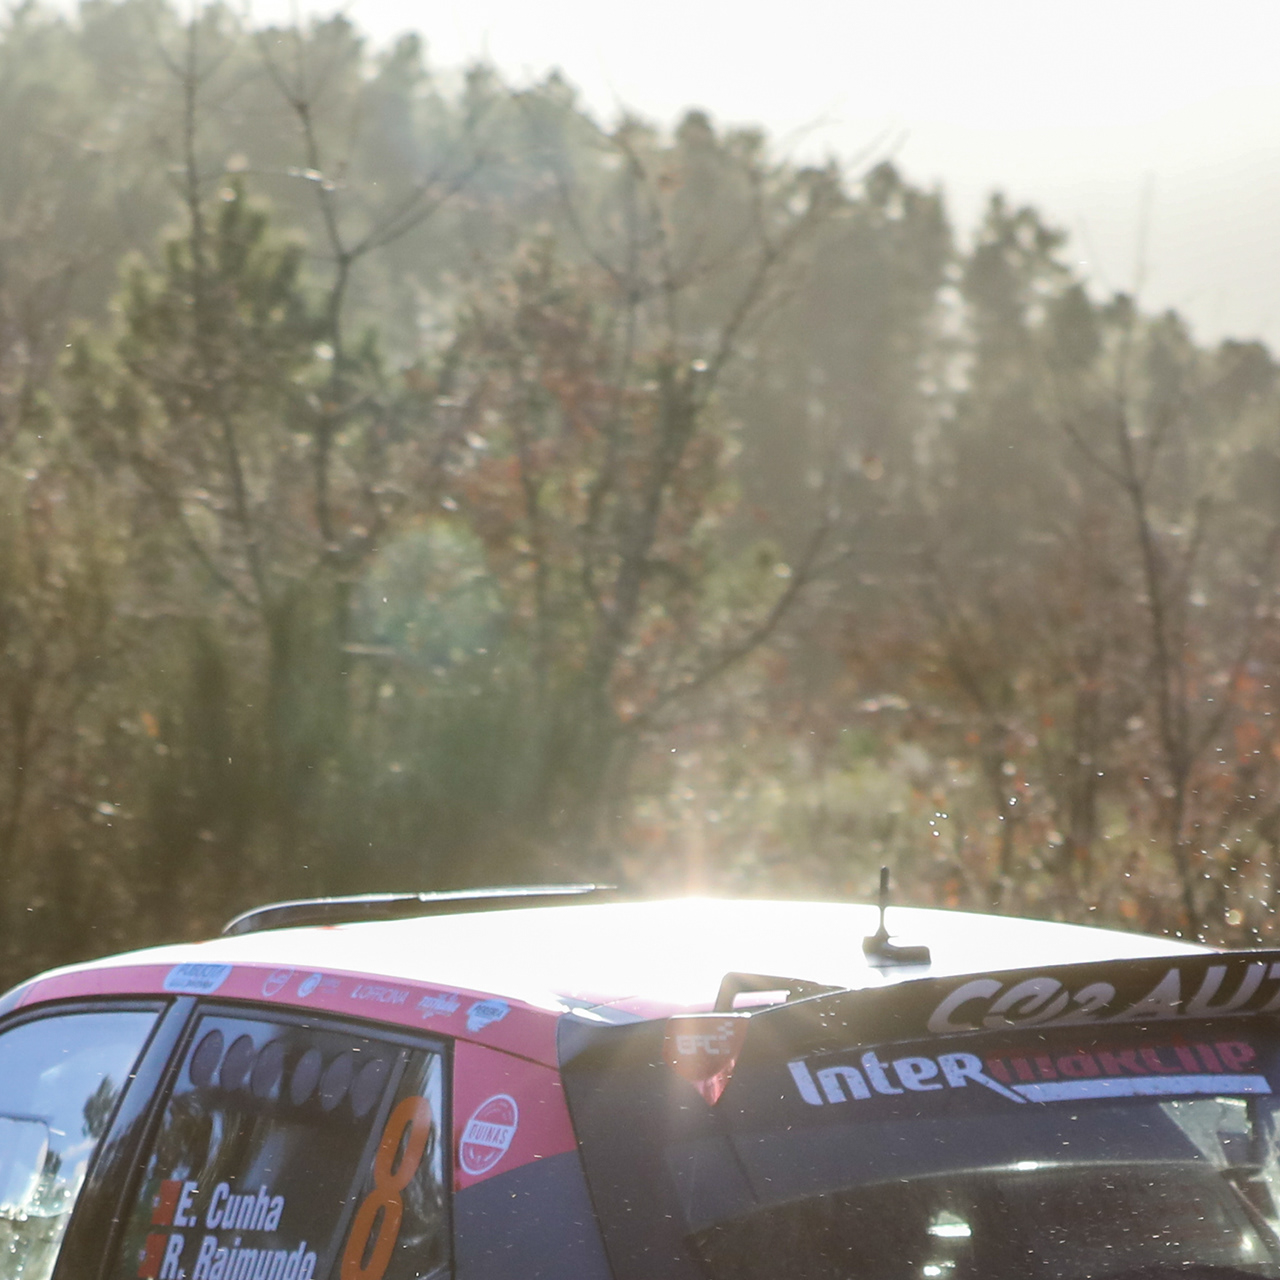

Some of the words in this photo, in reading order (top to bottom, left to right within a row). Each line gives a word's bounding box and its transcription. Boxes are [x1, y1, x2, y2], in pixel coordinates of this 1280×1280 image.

[173, 1181, 196, 1228] E.
[205, 1182, 285, 1232] Cunha
[159, 1235, 185, 1280] R.
